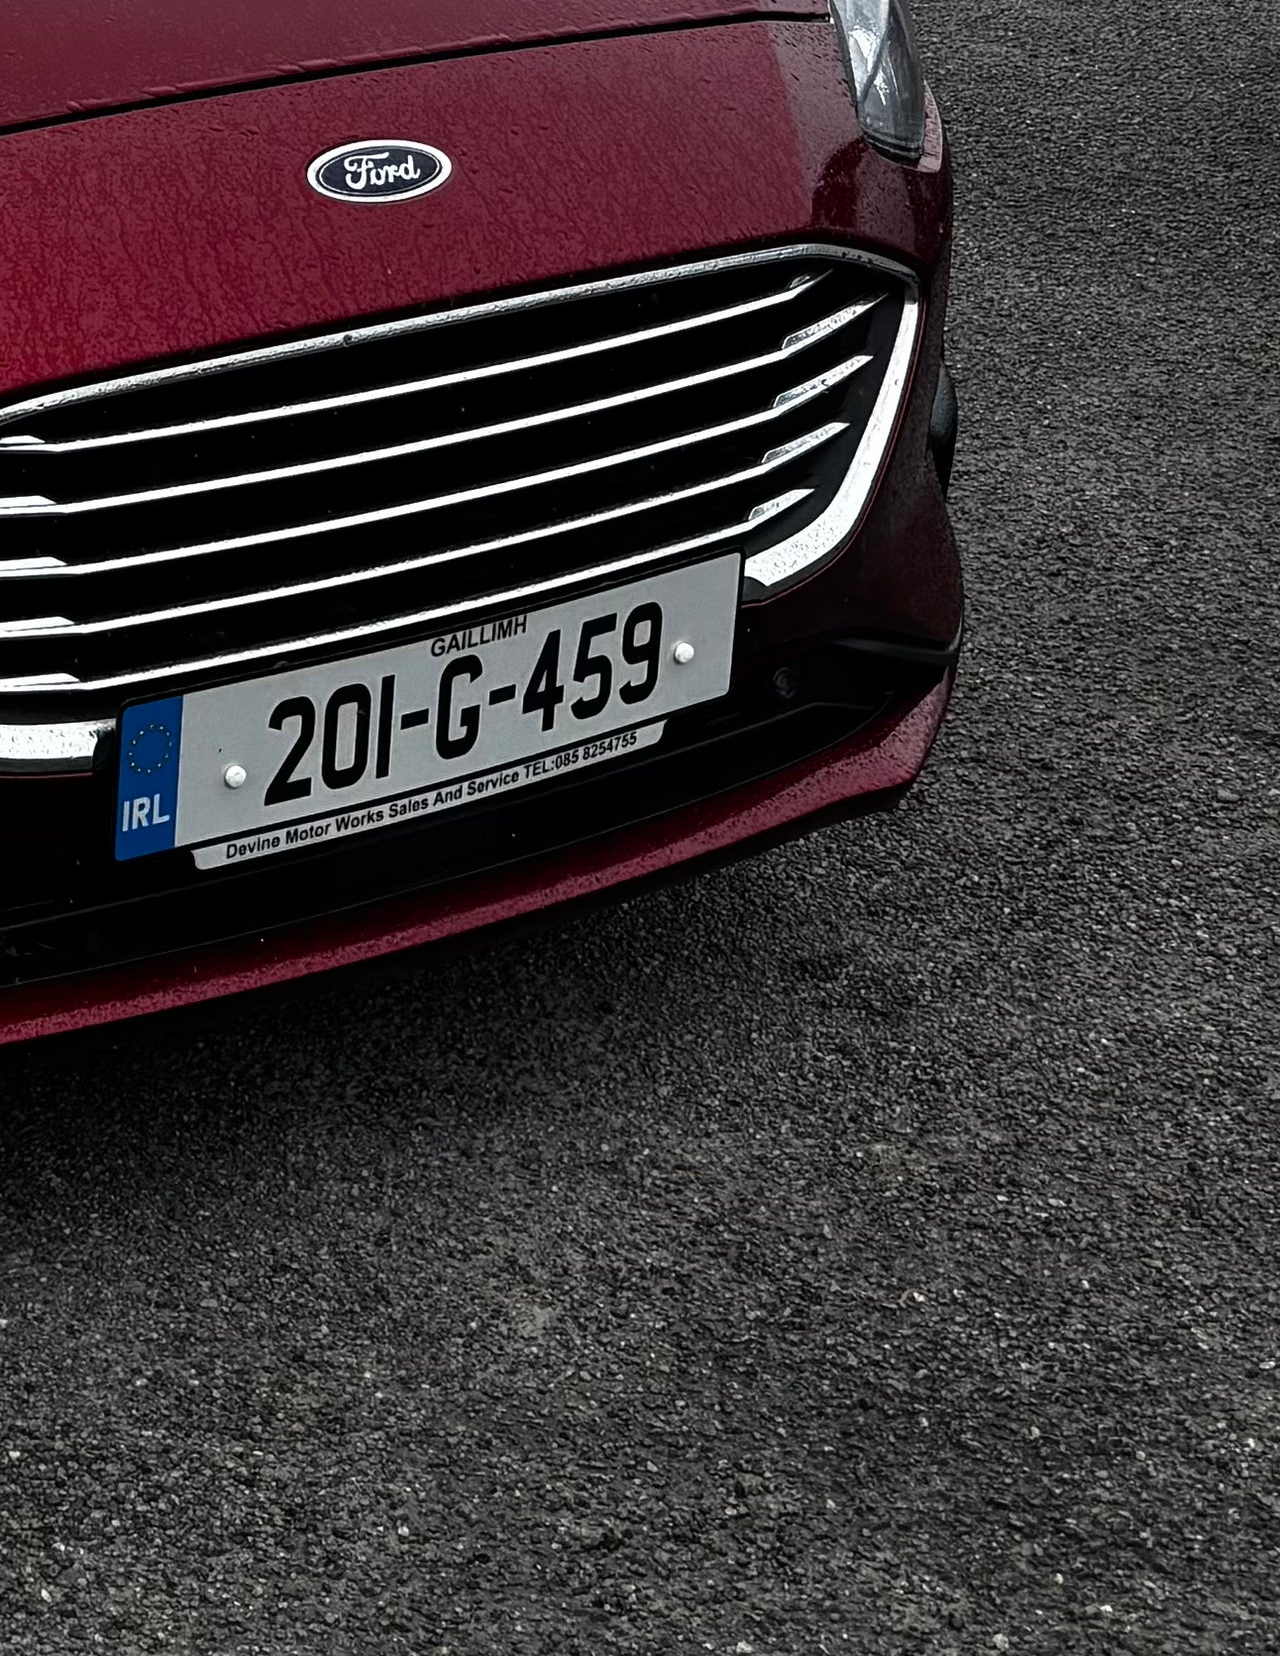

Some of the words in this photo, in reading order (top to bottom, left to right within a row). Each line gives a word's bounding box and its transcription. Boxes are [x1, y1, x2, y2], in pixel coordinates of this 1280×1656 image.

[344, 151, 421, 190] Ford
[431, 614, 528, 658] GAILLIMH
[264, 601, 663, 807] 201-G-459
[121, 792, 170, 832] IRL
[225, 836, 280, 859] Devine
[285, 822, 331, 845] Motor
[336, 808, 384, 833] Works
[388, 797, 429, 820] Sales
[433, 785, 463, 807] And
[467, 770, 519, 796] Service
[522, 748, 580, 780] TEL:085
[582, 730, 638, 761] 8254755
